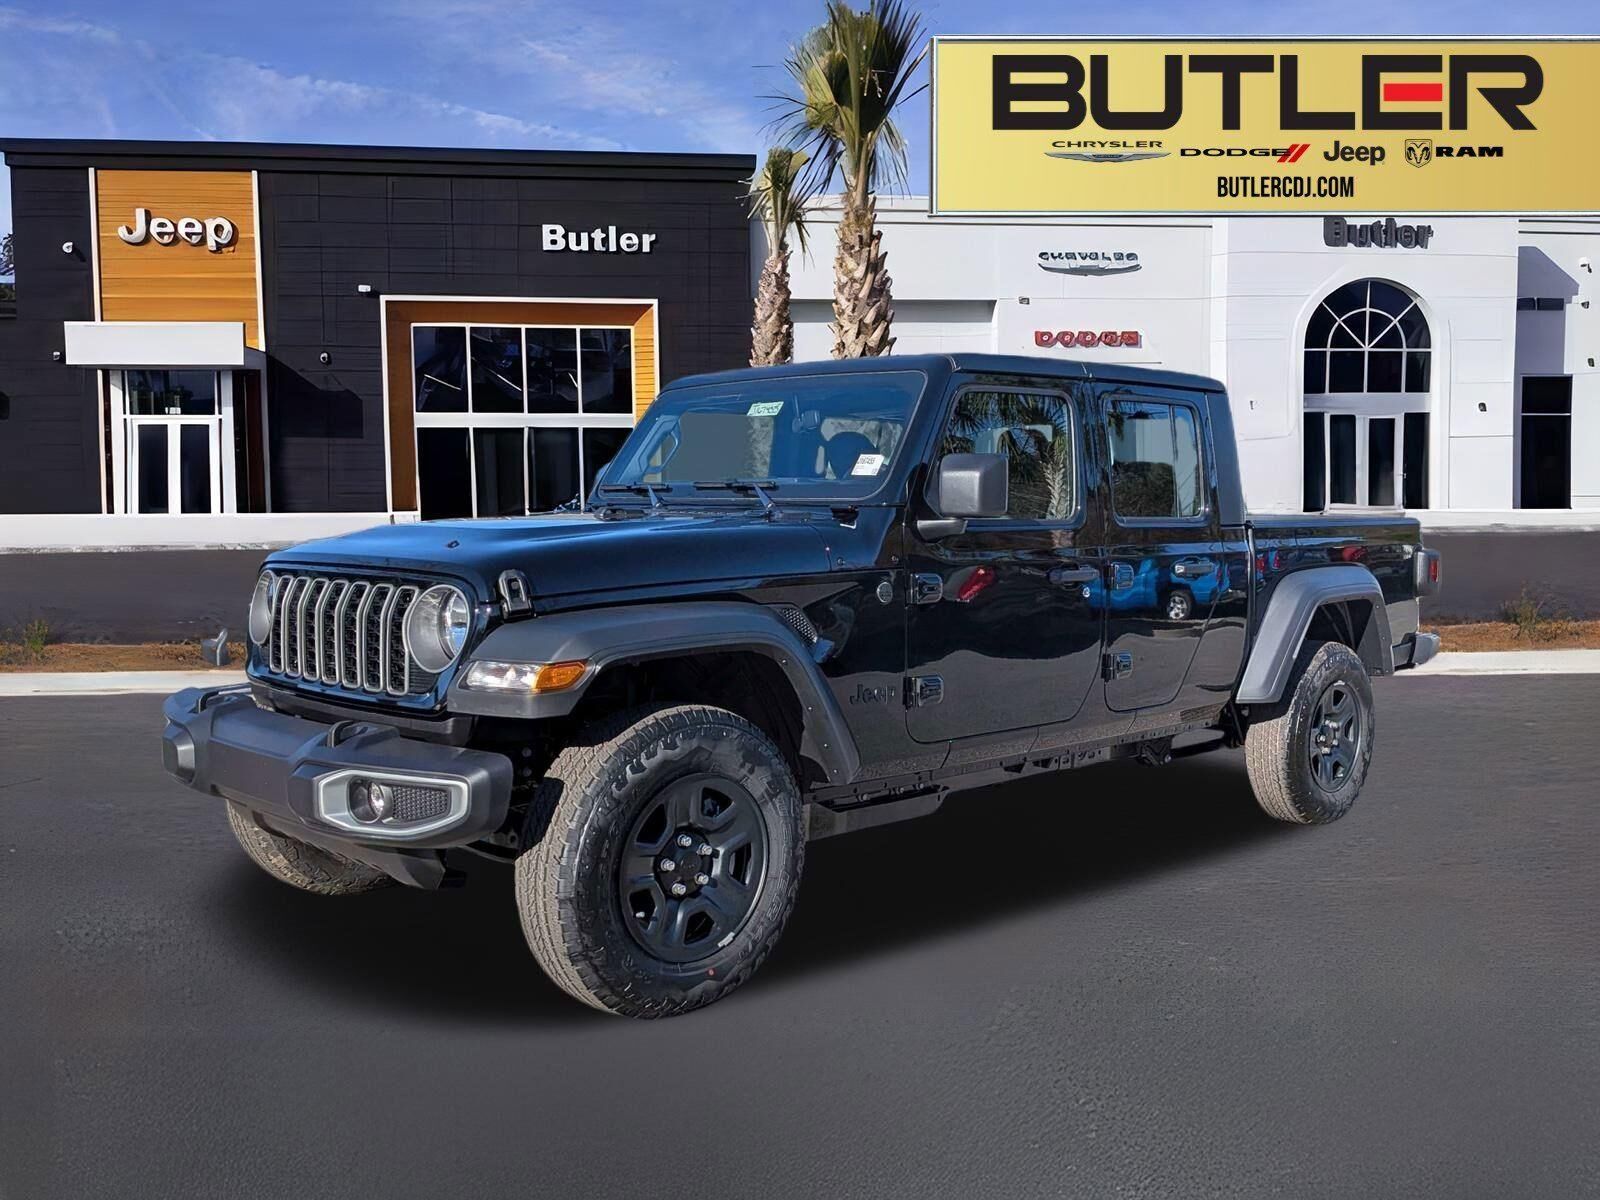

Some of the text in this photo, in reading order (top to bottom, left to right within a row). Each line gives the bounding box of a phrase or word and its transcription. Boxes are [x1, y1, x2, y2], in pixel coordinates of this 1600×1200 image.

[117, 207, 235, 252] Jeep
[541, 223, 657, 253] Butler
[1323, 216, 1434, 249] Butler
